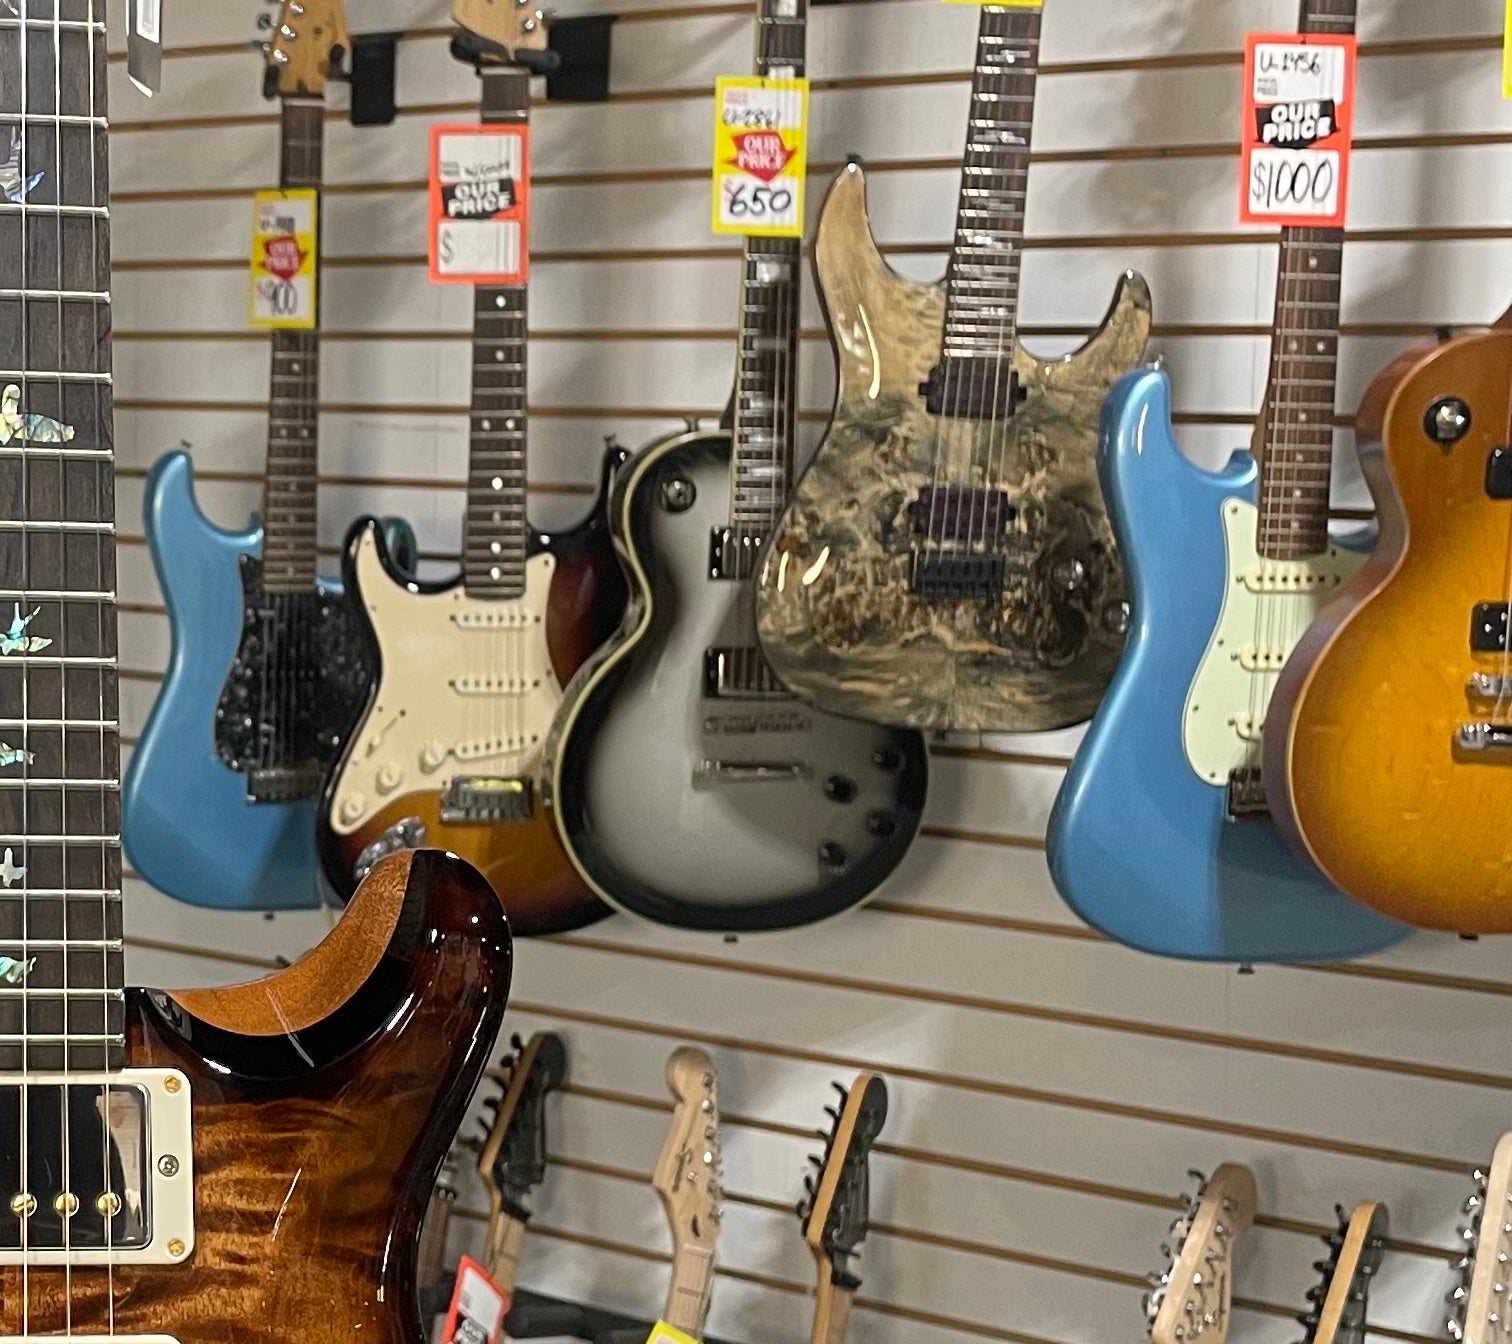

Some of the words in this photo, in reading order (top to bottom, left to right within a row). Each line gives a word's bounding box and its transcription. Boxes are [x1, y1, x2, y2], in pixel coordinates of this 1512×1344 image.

[1270, 102, 1321, 124] OUR
[1262, 115, 1332, 145] PRICE
[743, 135, 781, 152] OUR
[737, 150, 787, 170] PRICE
[454, 180, 501, 201] OUR
[1253, 158, 1334, 209] $1000
[447, 192, 512, 217] PRICE
[723, 177, 792, 217] $650
